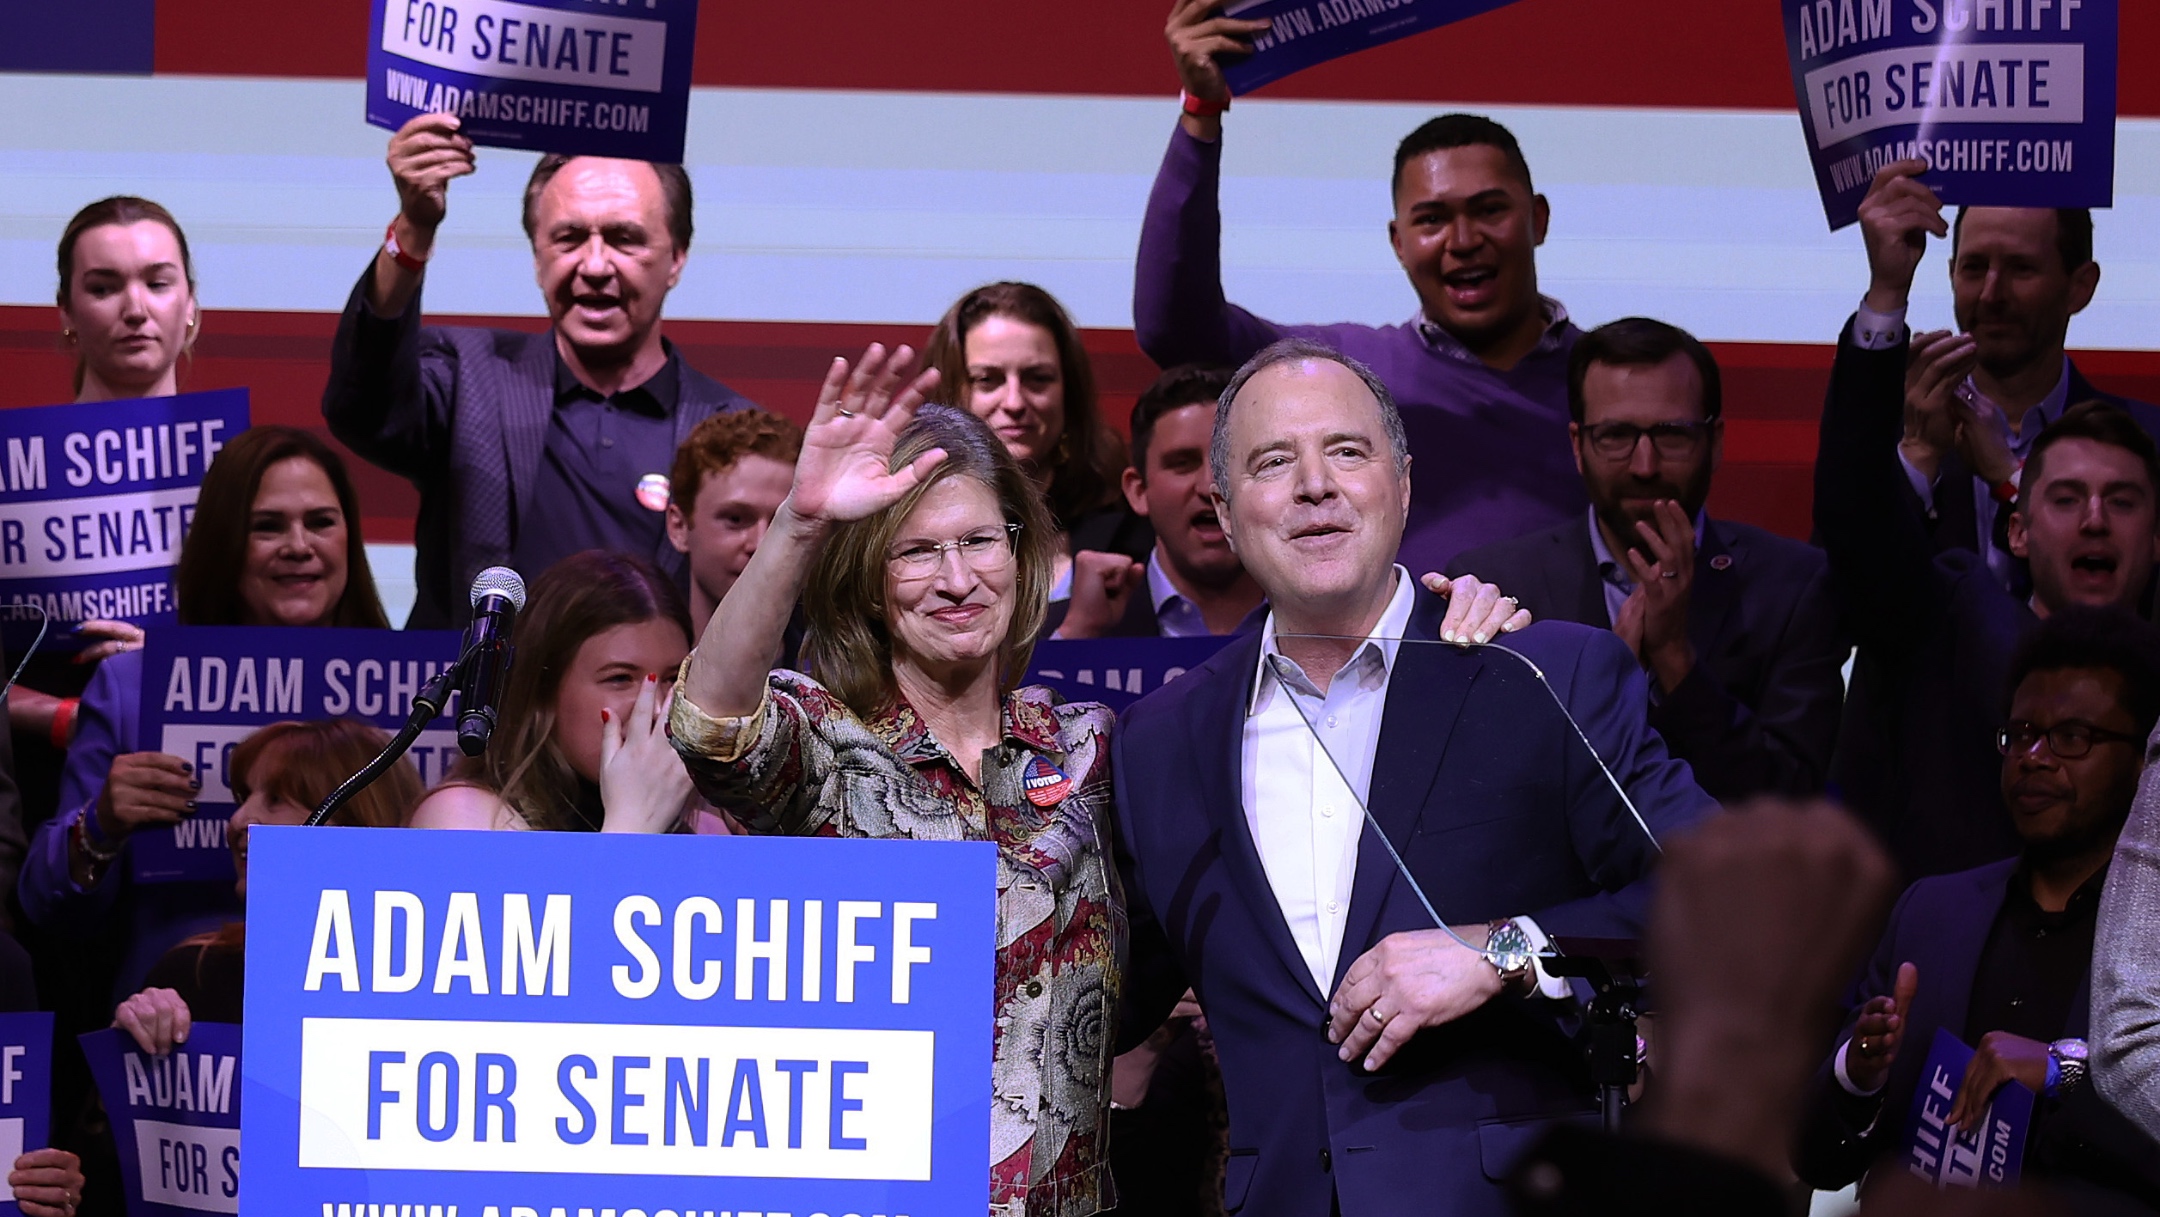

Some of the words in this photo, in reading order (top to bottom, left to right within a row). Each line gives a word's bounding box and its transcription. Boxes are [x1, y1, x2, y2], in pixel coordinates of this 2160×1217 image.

[471, 14, 633, 77] SENATE
[1801, 0, 1892, 61] ADAM
[386, 67, 650, 134] WWW.ADAMSCHIFF.COM
[1823, 70, 1872, 130] FOR
[1885, 60, 2050, 111] SENATE
[1829, 139, 2073, 195] WWW.ADAMSCHIFF.COM
[64, 419, 225, 488] SCHIFF
[164, 657, 304, 713] ADAM
[304, 889, 572, 997] ADAM
[611, 895, 938, 1004] SCHIFF
[124, 1052, 236, 1114] ADAM
[366, 1050, 517, 1143] FOR
[554, 1053, 869, 1150] SENATE
[160, 1138, 208, 1195] FOR
